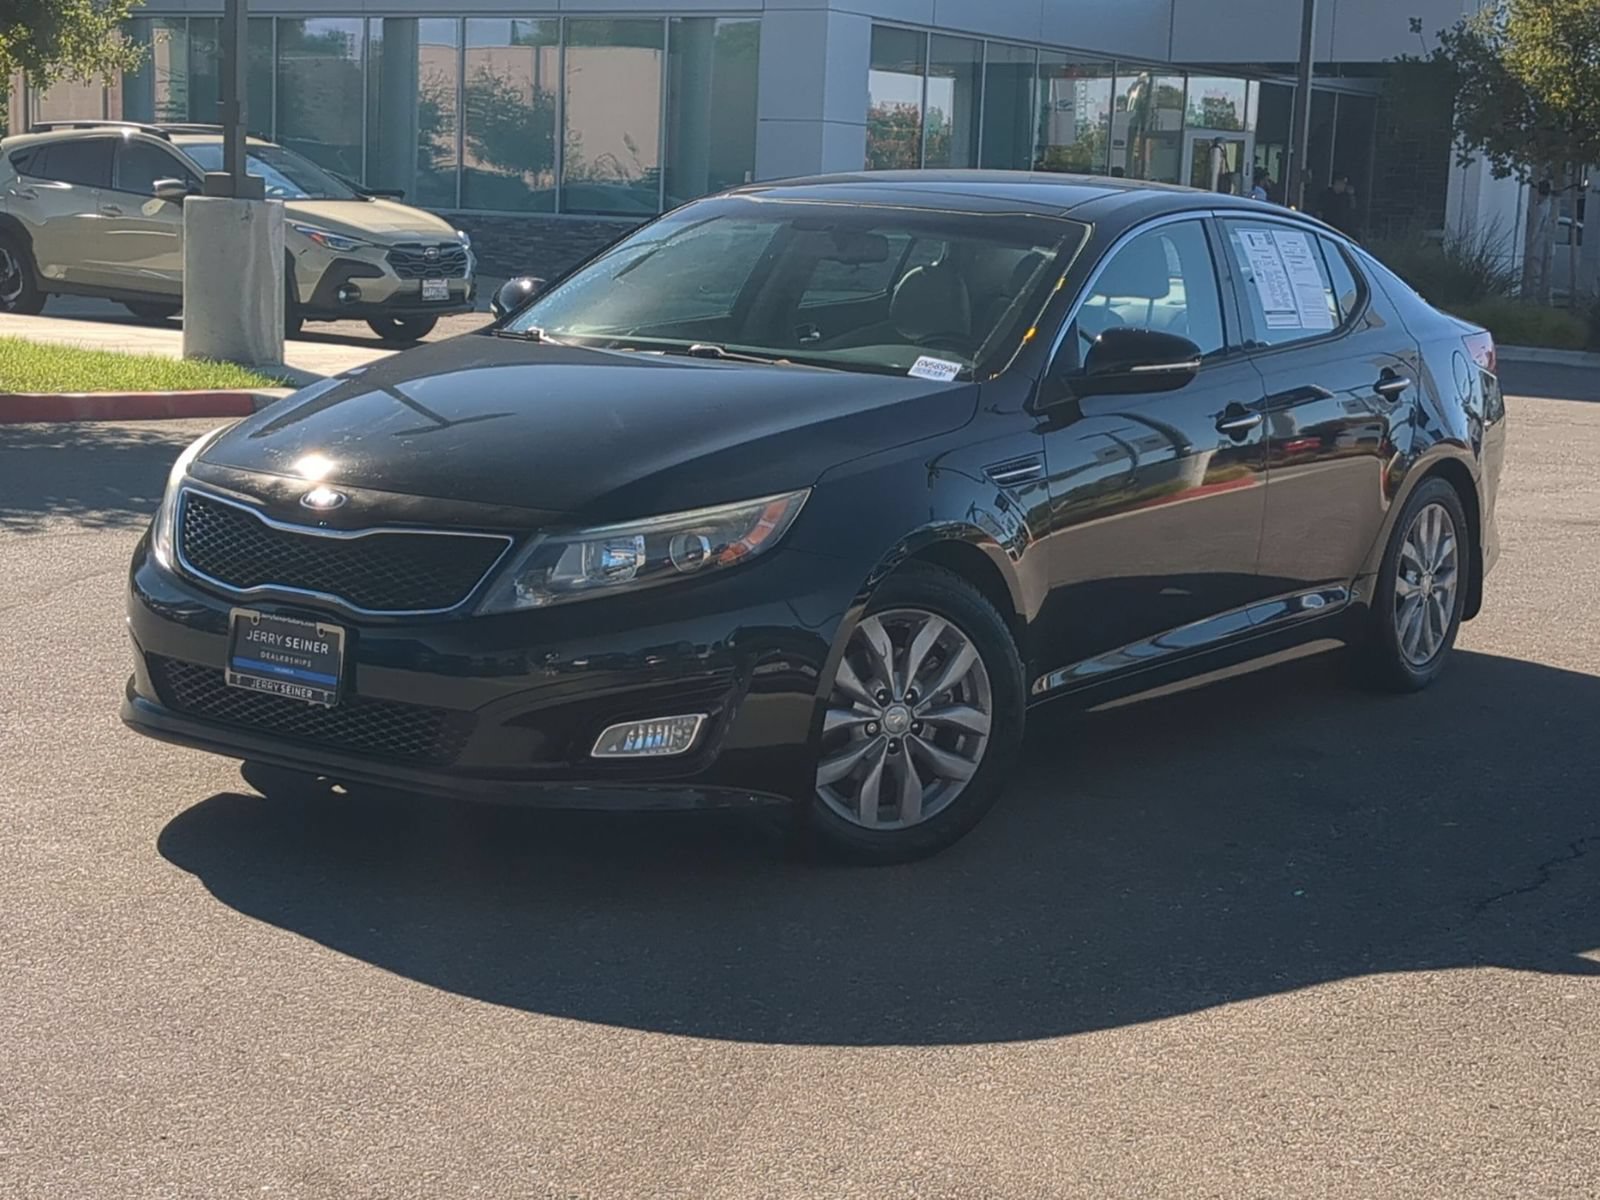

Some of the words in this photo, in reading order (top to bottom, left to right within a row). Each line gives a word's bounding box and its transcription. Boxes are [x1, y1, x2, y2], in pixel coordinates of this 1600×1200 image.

[246, 630, 283, 645] JERRY
[285, 636, 329, 655] SEINER
[260, 651, 312, 668] DEALERSHIPS
[251, 680, 279, 692] JERRY
[280, 684, 313, 699] SEINER
